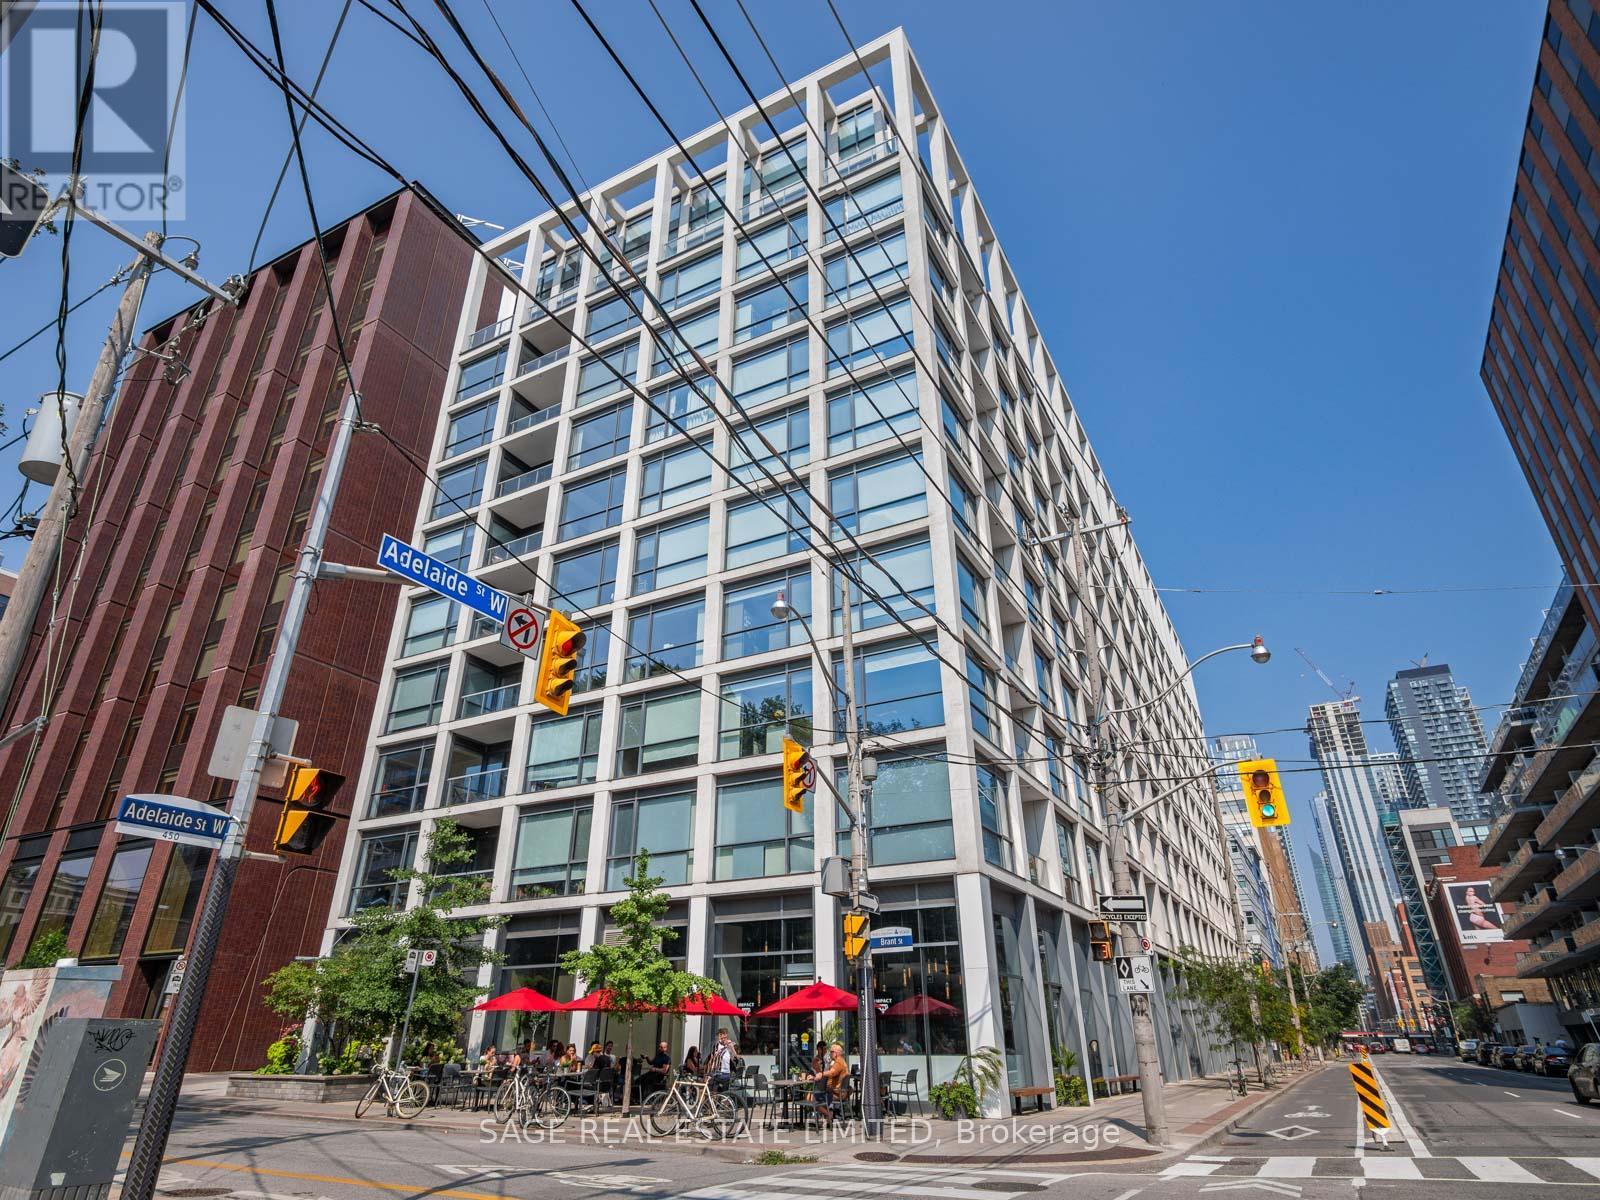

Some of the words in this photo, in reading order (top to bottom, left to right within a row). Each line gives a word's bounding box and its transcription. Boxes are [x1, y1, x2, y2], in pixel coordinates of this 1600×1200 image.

[384, 541, 468, 596] Adelaide
[476, 585, 485, 597] St
[490, 592, 506, 615] W
[124, 803, 192, 829] Adelaide
[194, 818, 207, 832] St
[213, 819, 227, 835] W
[162, 831, 180, 841] 450
[880, 937, 897, 946] Brant
